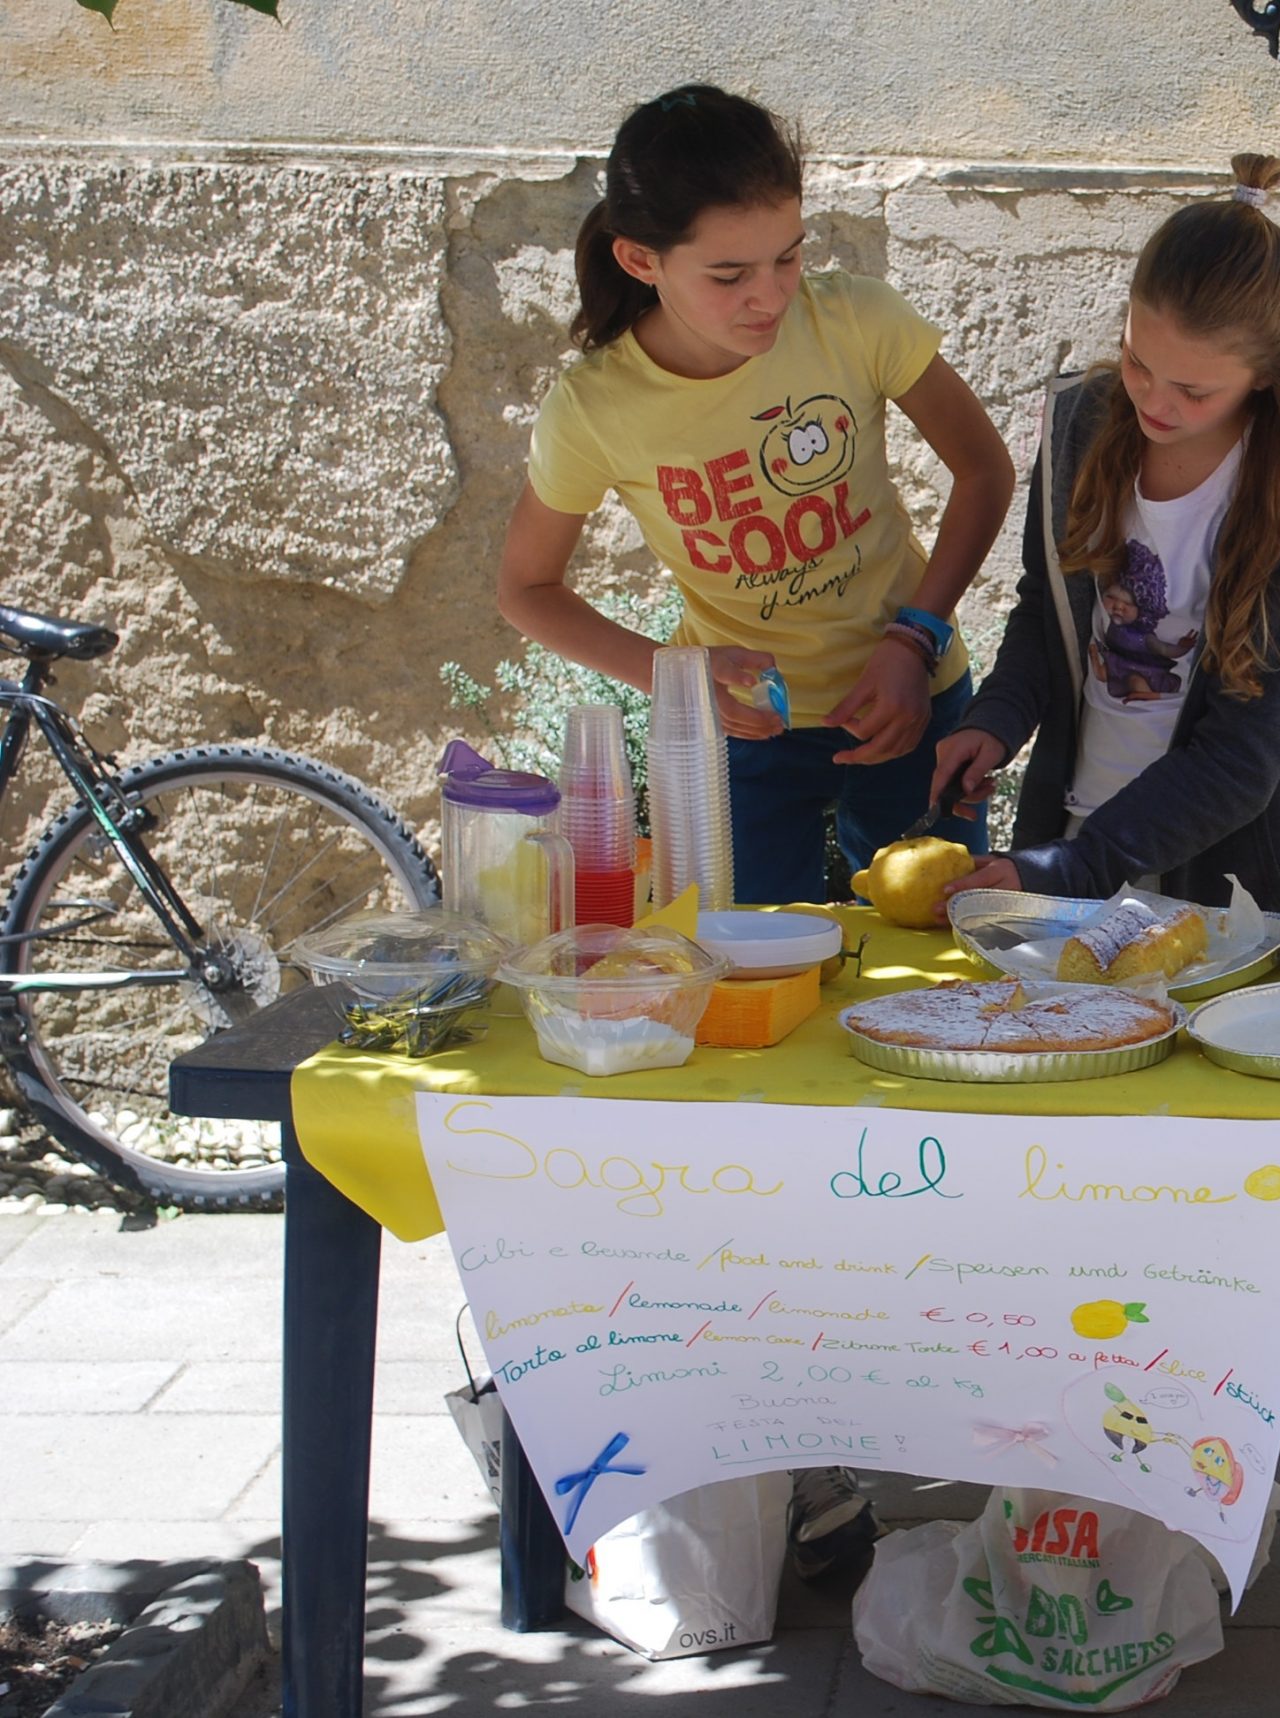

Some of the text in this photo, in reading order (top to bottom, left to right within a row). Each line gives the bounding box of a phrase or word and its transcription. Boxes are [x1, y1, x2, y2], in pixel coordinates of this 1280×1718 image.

[656, 448, 763, 527] BE
[680, 481, 872, 575] COOL
[734, 556, 824, 595] Always
[443, 1100, 1237, 1217] Sagra del limone
[459, 1238, 535, 1272] Cibi
[549, 1246, 568, 1257] e
[581, 1240, 691, 1263] bevande
[779, 1258, 824, 1270] and
[834, 1259, 898, 1275] drink
[1068, 1264, 1128, 1279] und
[1144, 1262, 1261, 1295] Getränke
[485, 1300, 605, 1341] limonata
[966, 1312, 1037, 1328] 0,50
[576, 1335, 602, 1353] al
[608, 1330, 684, 1347] limone
[1068, 1352, 1086, 1363] a
[1094, 1350, 1140, 1371] fetta
[598, 1361, 728, 1397] Limoni
[760, 1360, 853, 1387] 2,00
[905, 1375, 939, 1388] al
